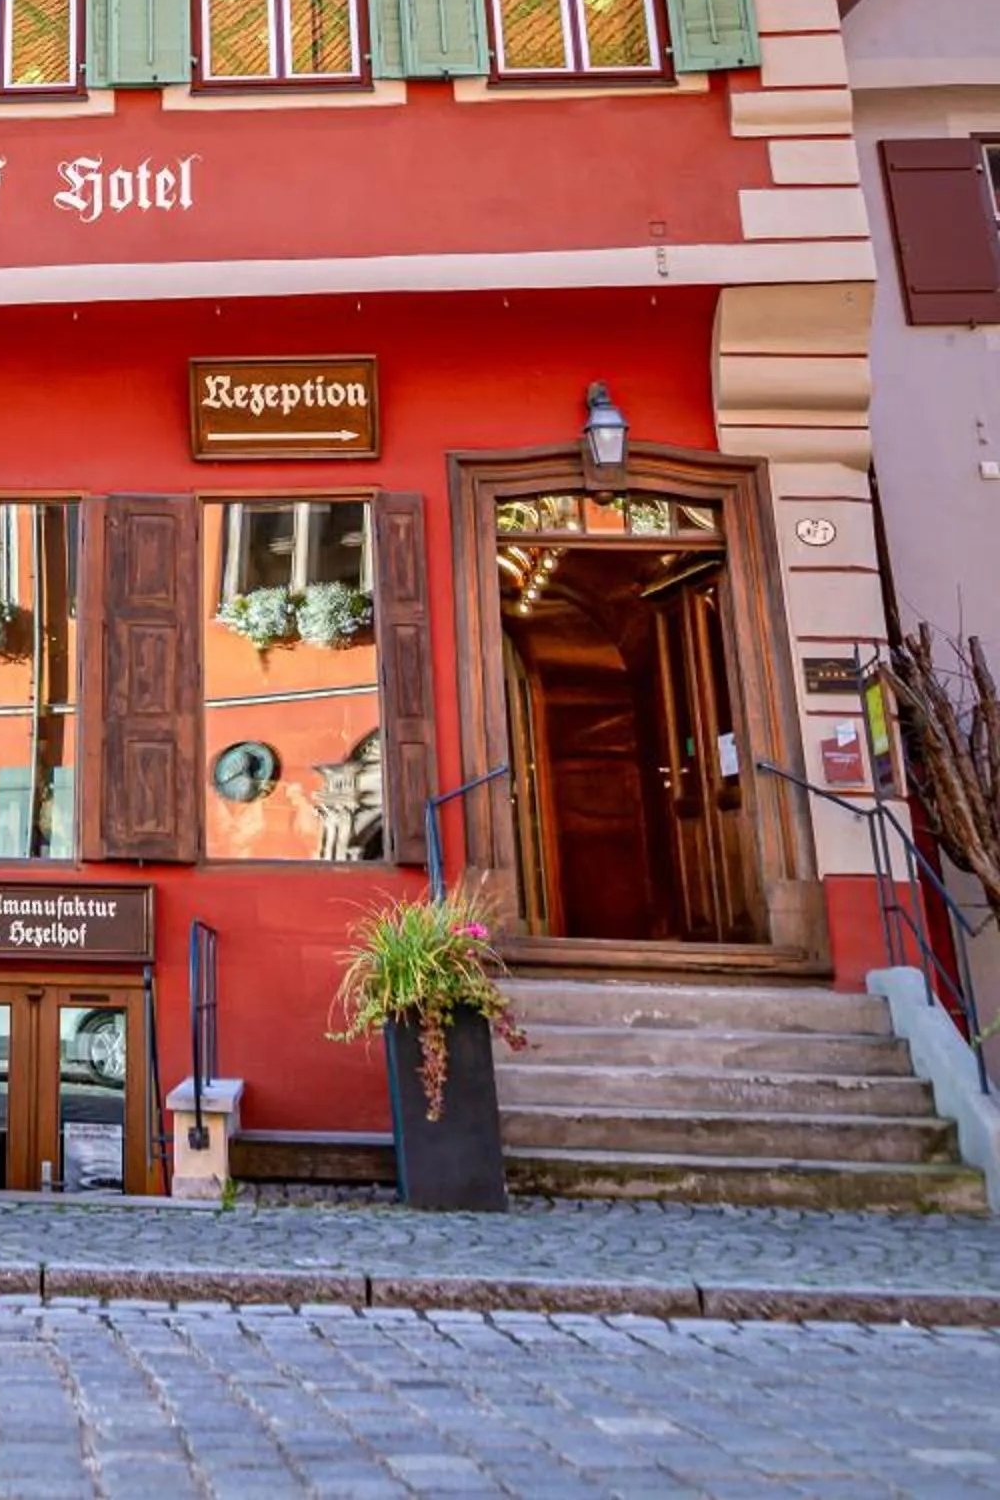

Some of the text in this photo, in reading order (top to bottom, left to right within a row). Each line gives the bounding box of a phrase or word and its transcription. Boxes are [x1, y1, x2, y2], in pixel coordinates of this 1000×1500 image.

[53, 153, 202, 223] Hotel
[202, 375, 368, 416] Rezeption
[9, 920, 87, 948] Hezelhof
